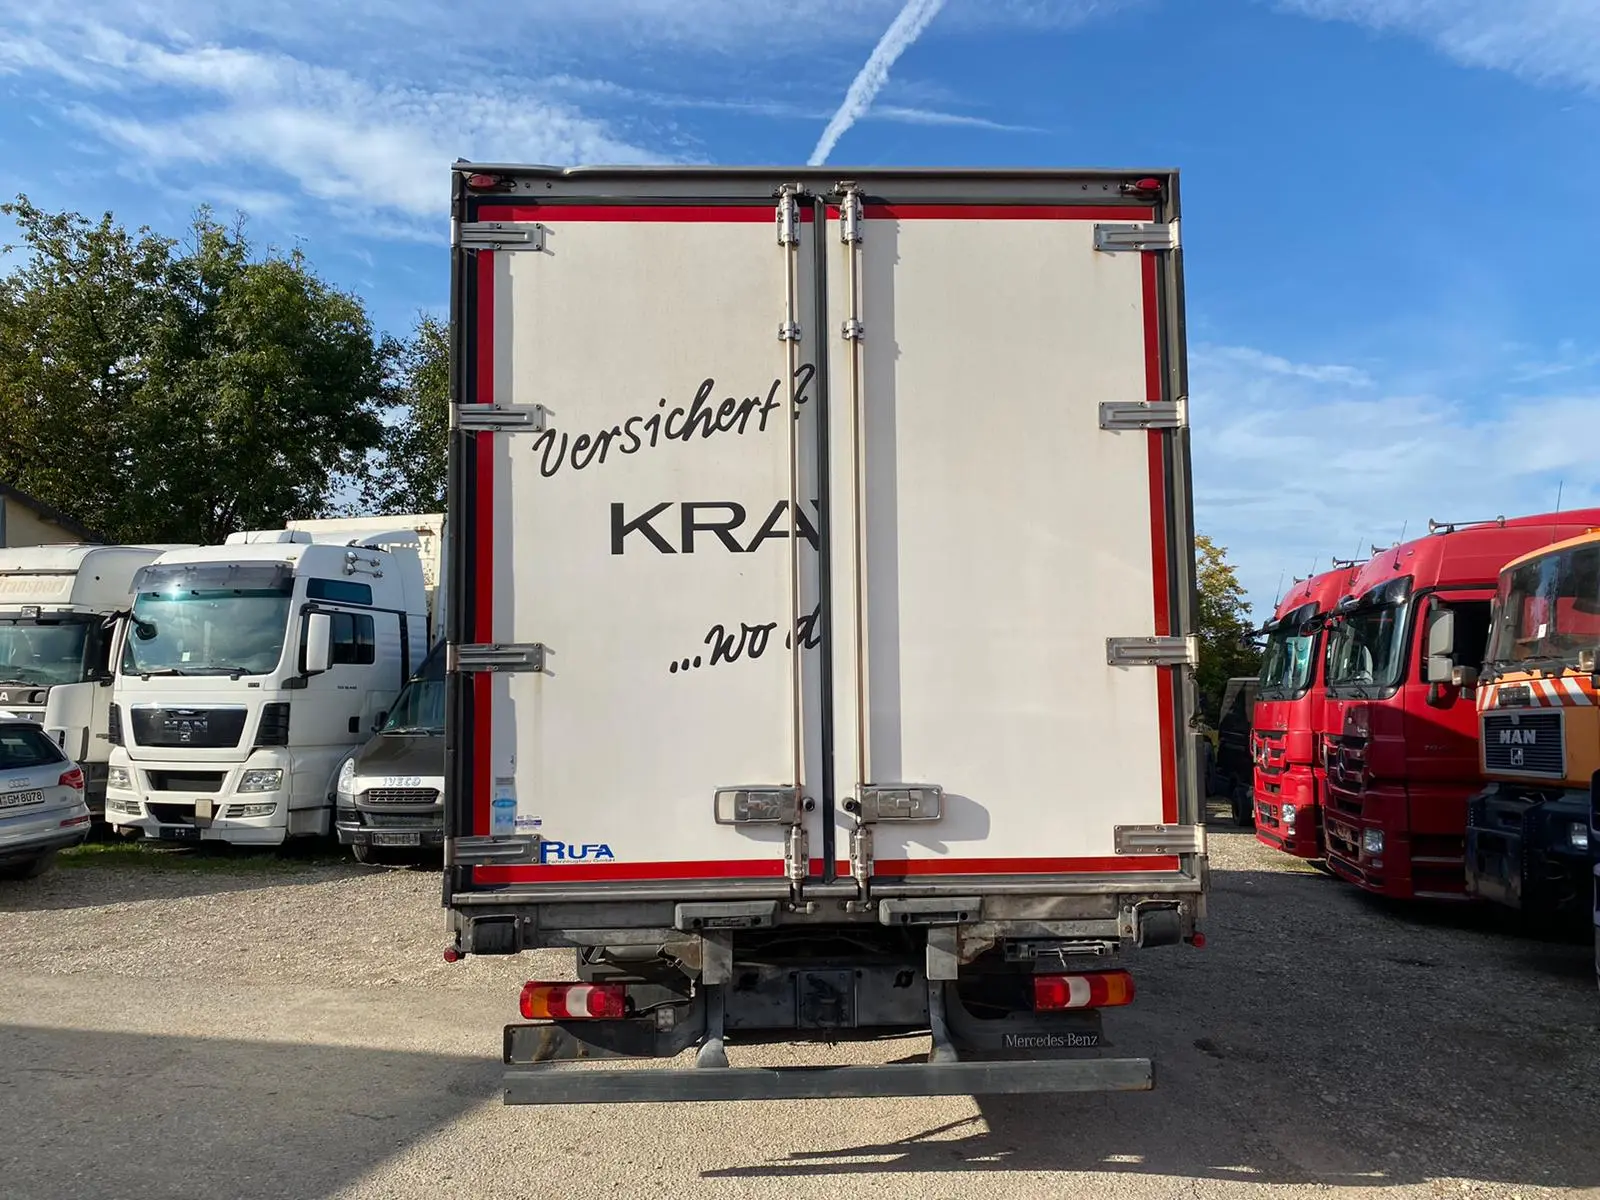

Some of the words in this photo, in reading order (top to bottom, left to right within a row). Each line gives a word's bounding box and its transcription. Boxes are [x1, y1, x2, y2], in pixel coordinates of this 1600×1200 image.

[164, 720, 208, 732] MAN
[1499, 728, 1536, 745] MAN
[383, 777, 421, 787] IVECO
[20, 791, 42, 803] 8078
[1005, 1032, 1099, 1048] Mercedes-Benz
